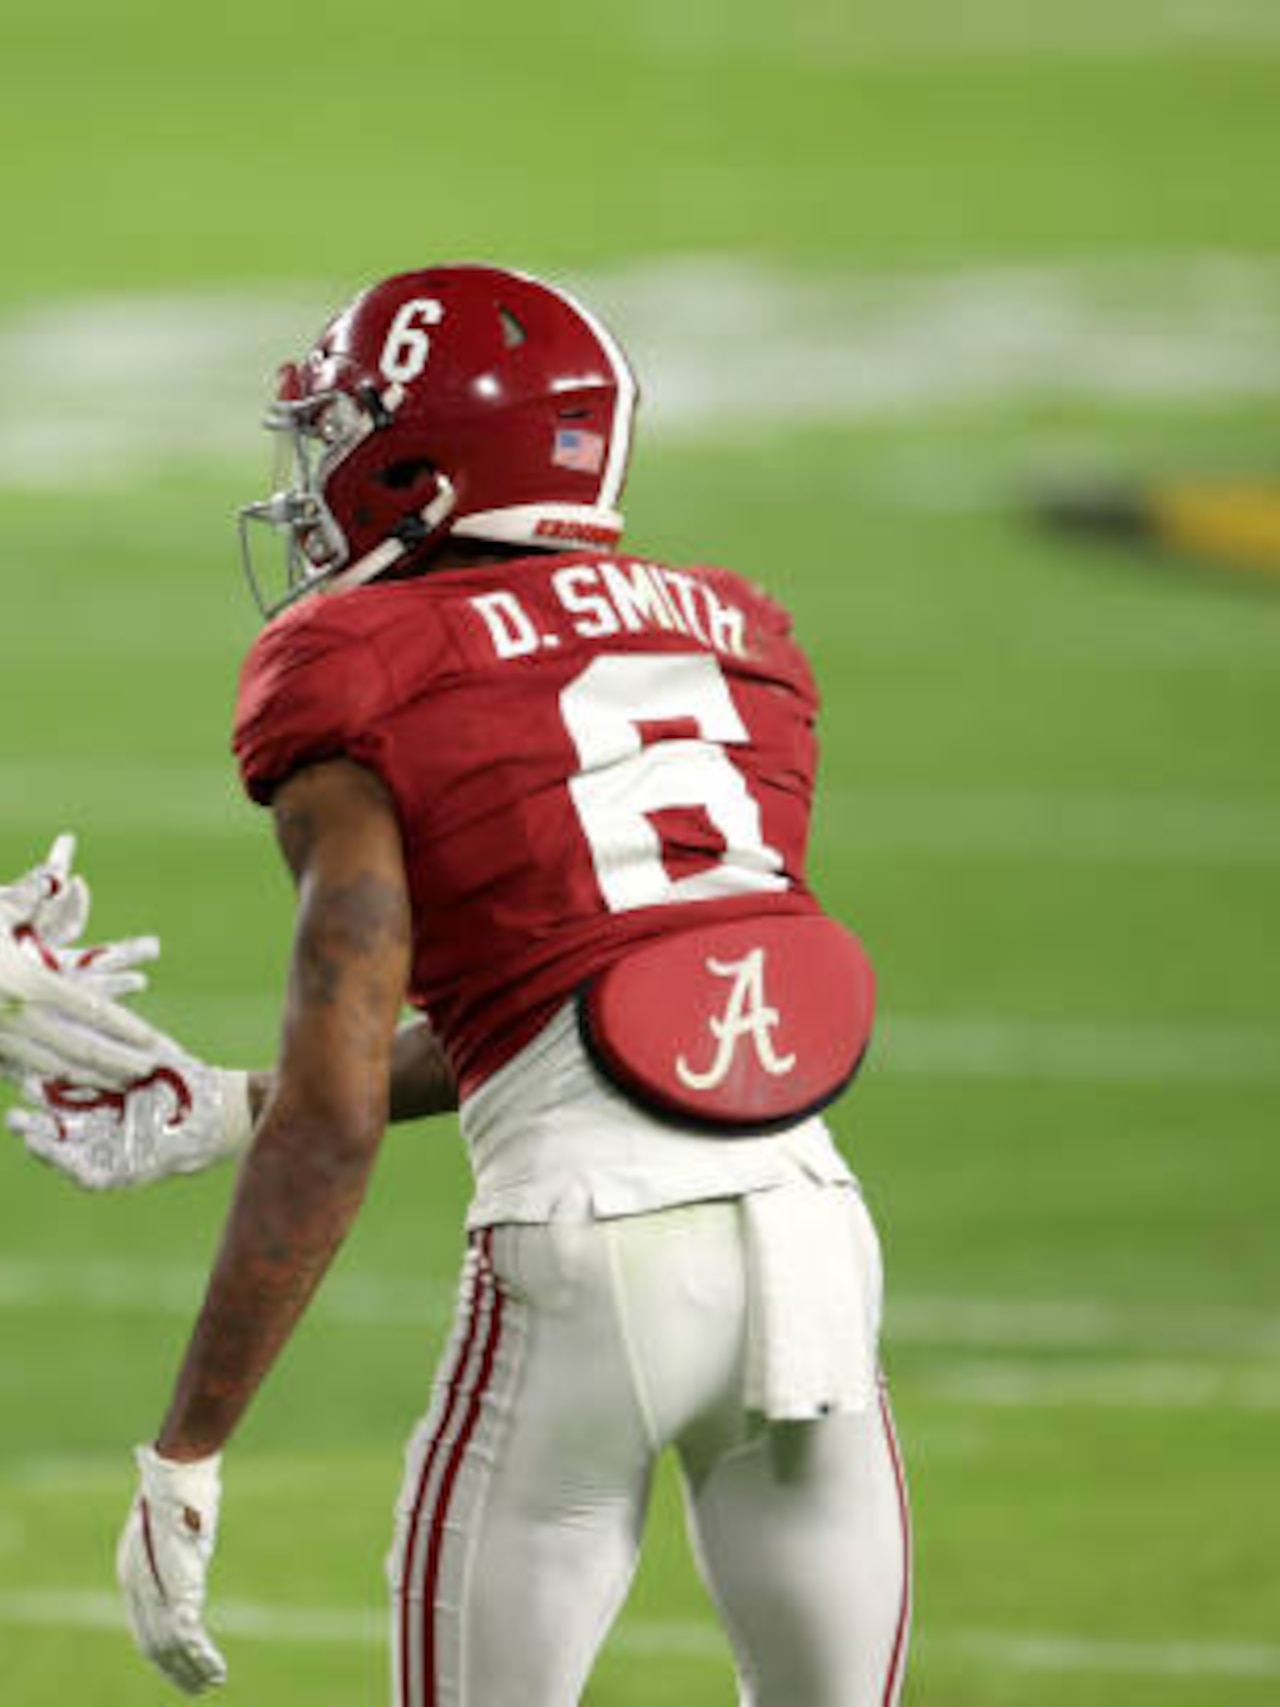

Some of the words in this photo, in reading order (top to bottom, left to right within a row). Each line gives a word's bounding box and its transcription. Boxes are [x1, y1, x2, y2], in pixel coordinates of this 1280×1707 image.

[380, 299, 443, 385] 6
[470, 591, 560, 659] D.
[551, 562, 746, 662] SMITH
[559, 653, 789, 913] 6
[676, 948, 796, 1090] A
